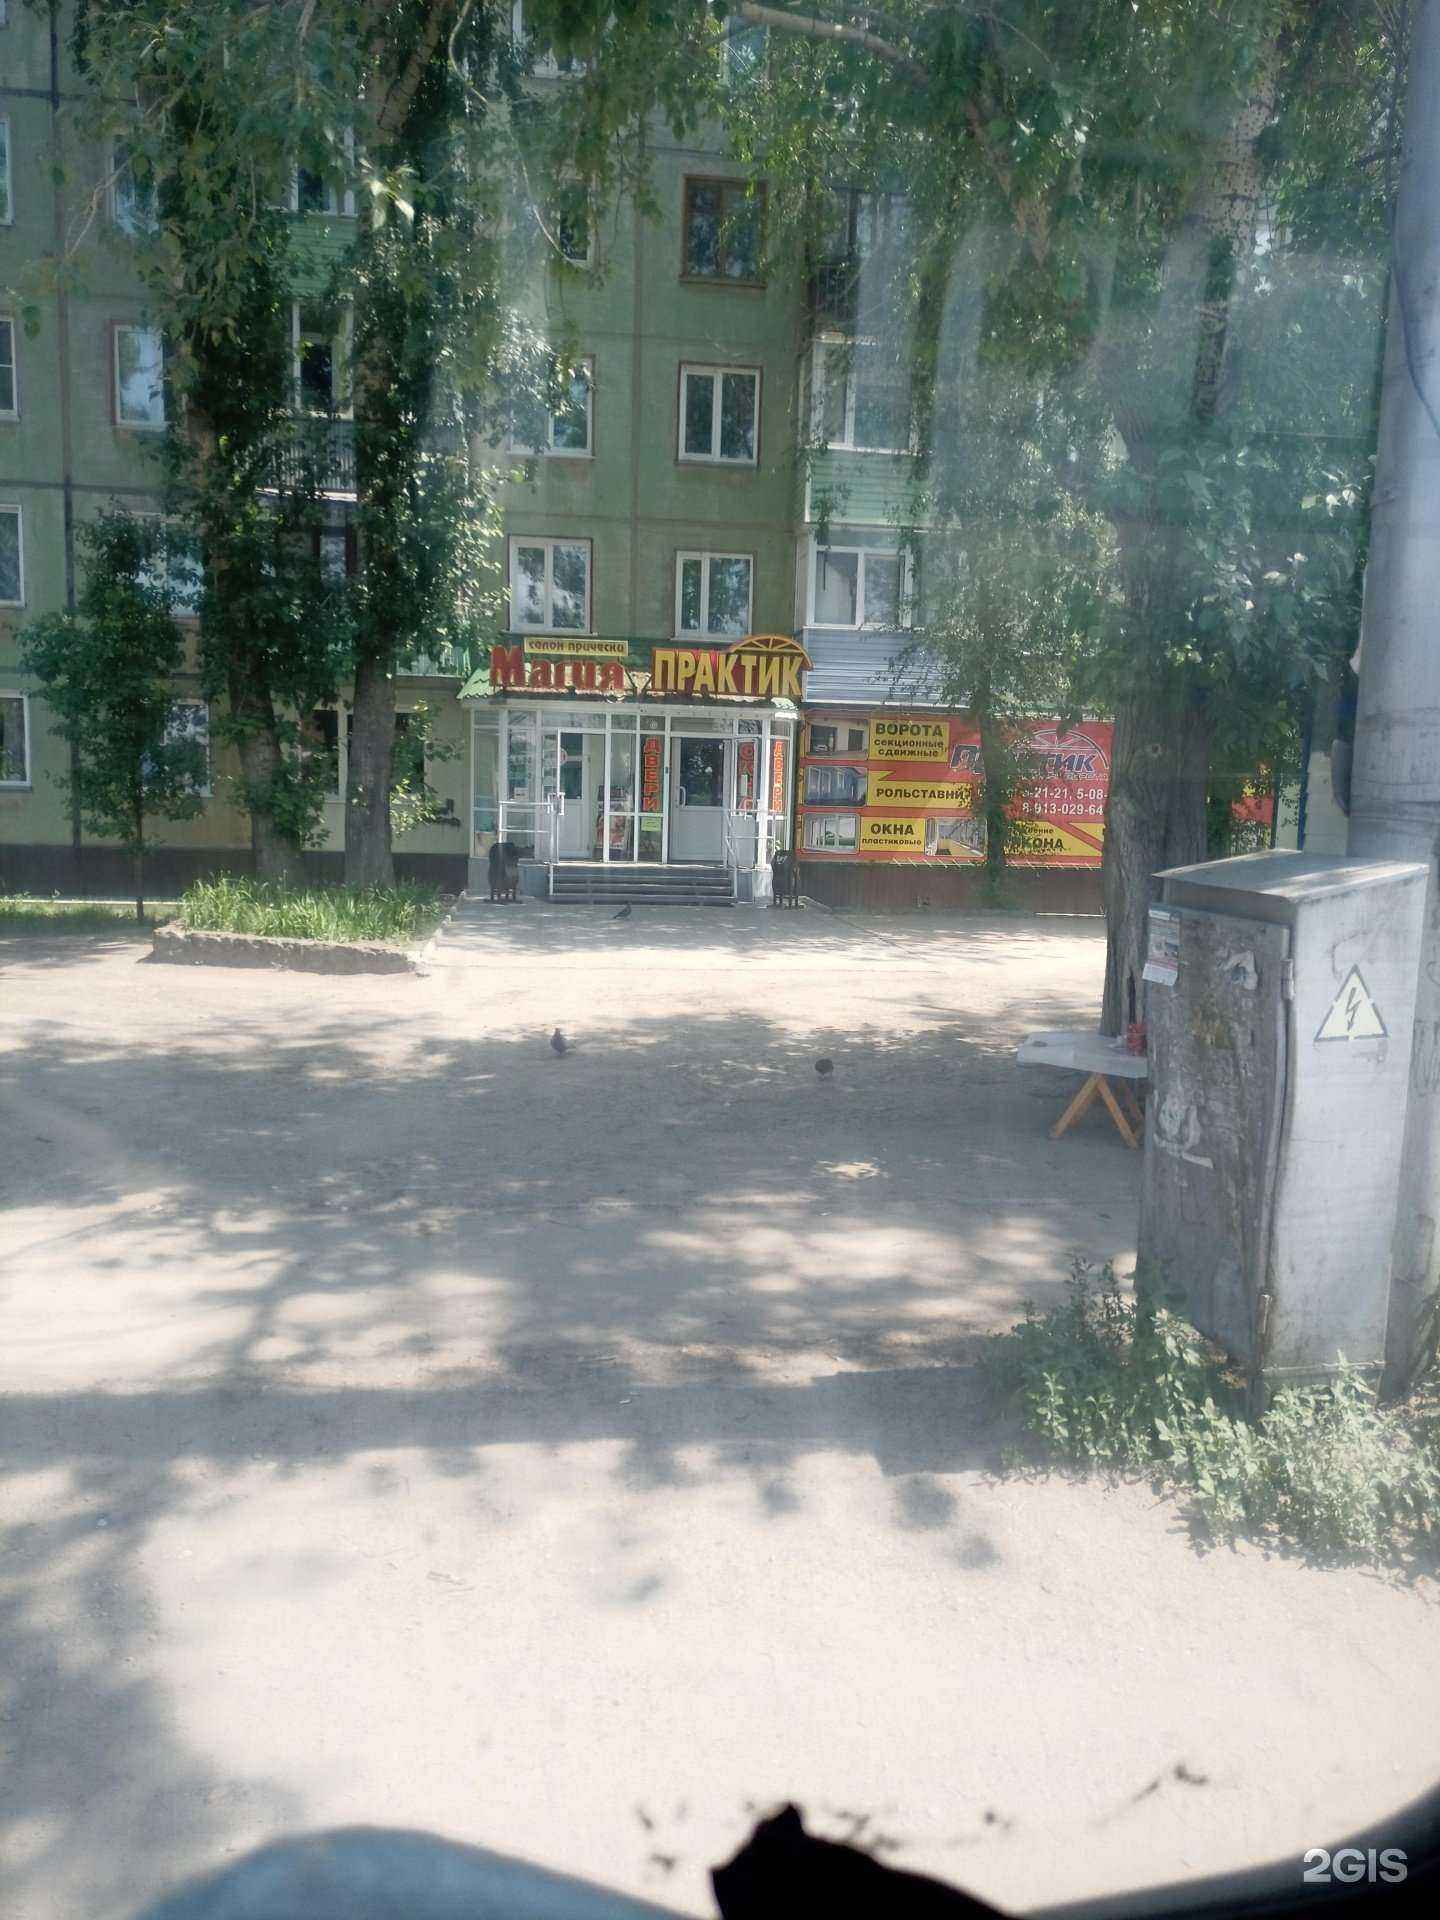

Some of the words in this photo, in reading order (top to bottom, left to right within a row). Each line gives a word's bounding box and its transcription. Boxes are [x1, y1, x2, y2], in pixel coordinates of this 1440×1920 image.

[490, 645, 625, 690] Магия
[654, 650, 803, 696] ПРАКТИК
[875, 723, 943, 737] ВОРОТА
[870, 823, 915, 835] ОКНА
